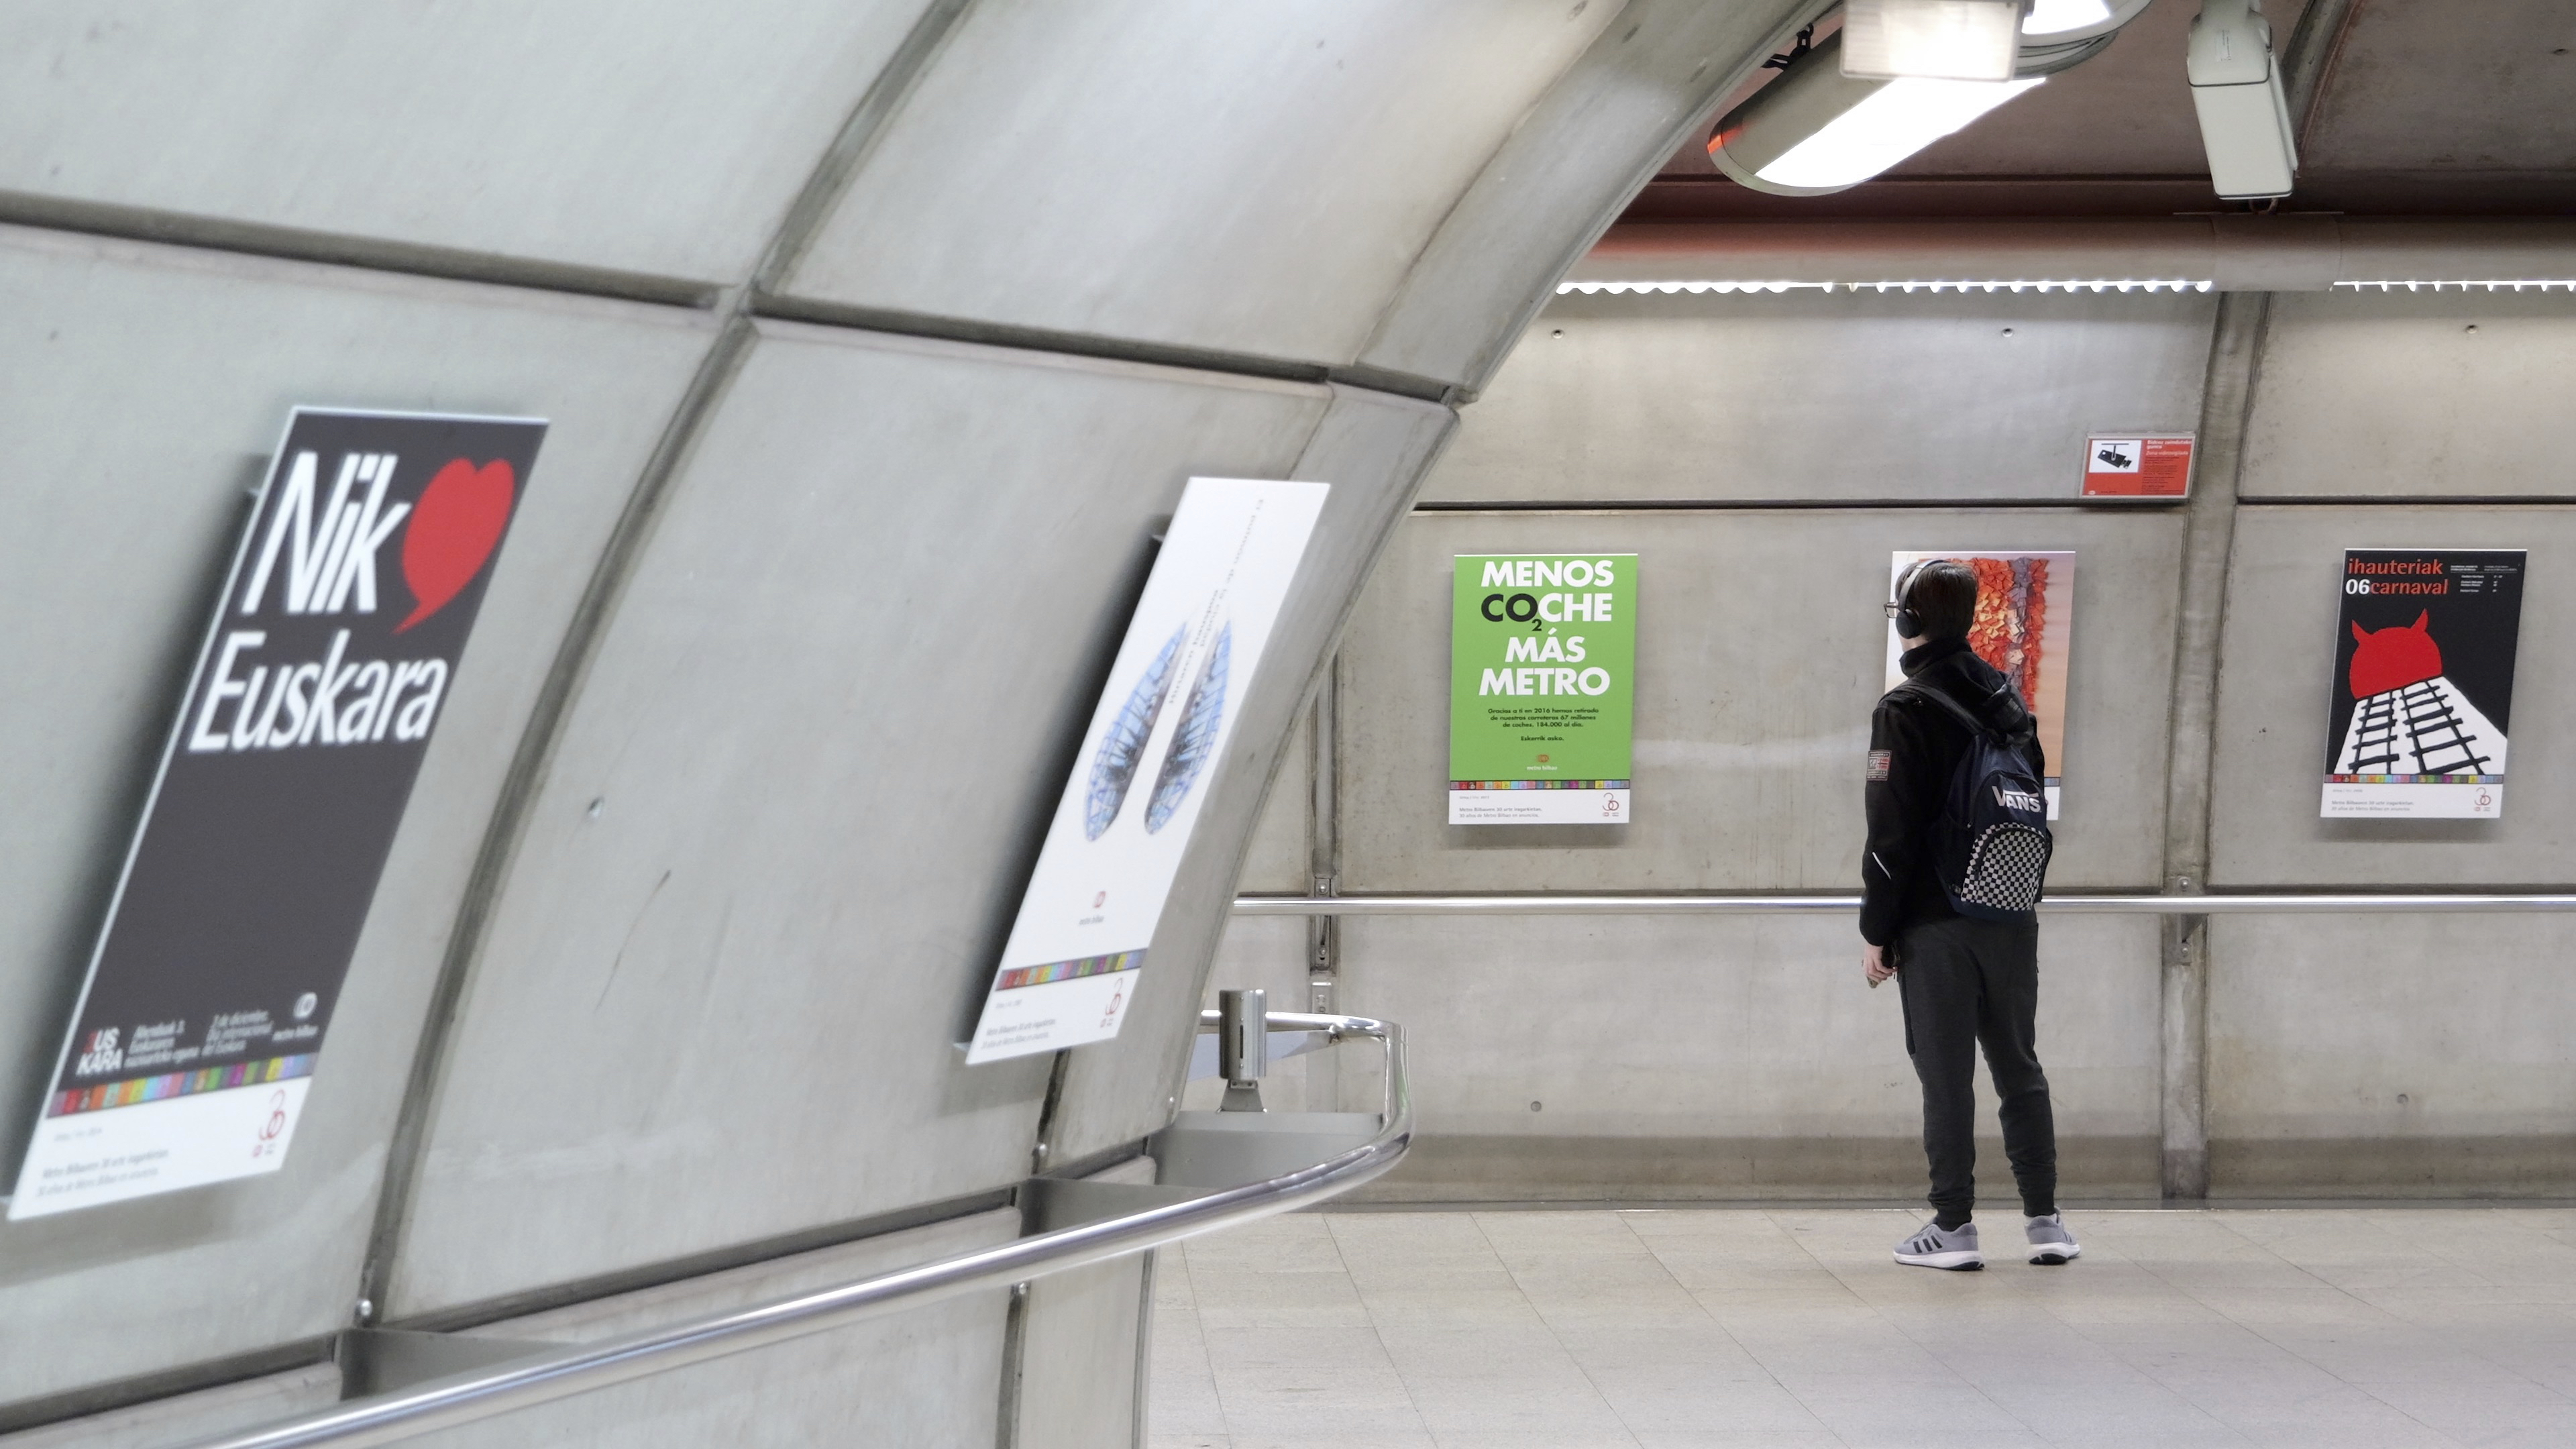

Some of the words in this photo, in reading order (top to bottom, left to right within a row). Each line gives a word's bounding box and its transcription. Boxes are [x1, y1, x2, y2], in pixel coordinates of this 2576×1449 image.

[240, 450, 413, 614] Nik
[1481, 559, 1615, 588] MENOS
[2348, 558, 2443, 575] ihauteriak
[1505, 627, 1586, 663] MÁS
[187, 629, 447, 752] Euskara
[1479, 667, 1611, 696] METRO
[1992, 786, 2042, 812] VANS
[76, 1048, 123, 1077] KARA
